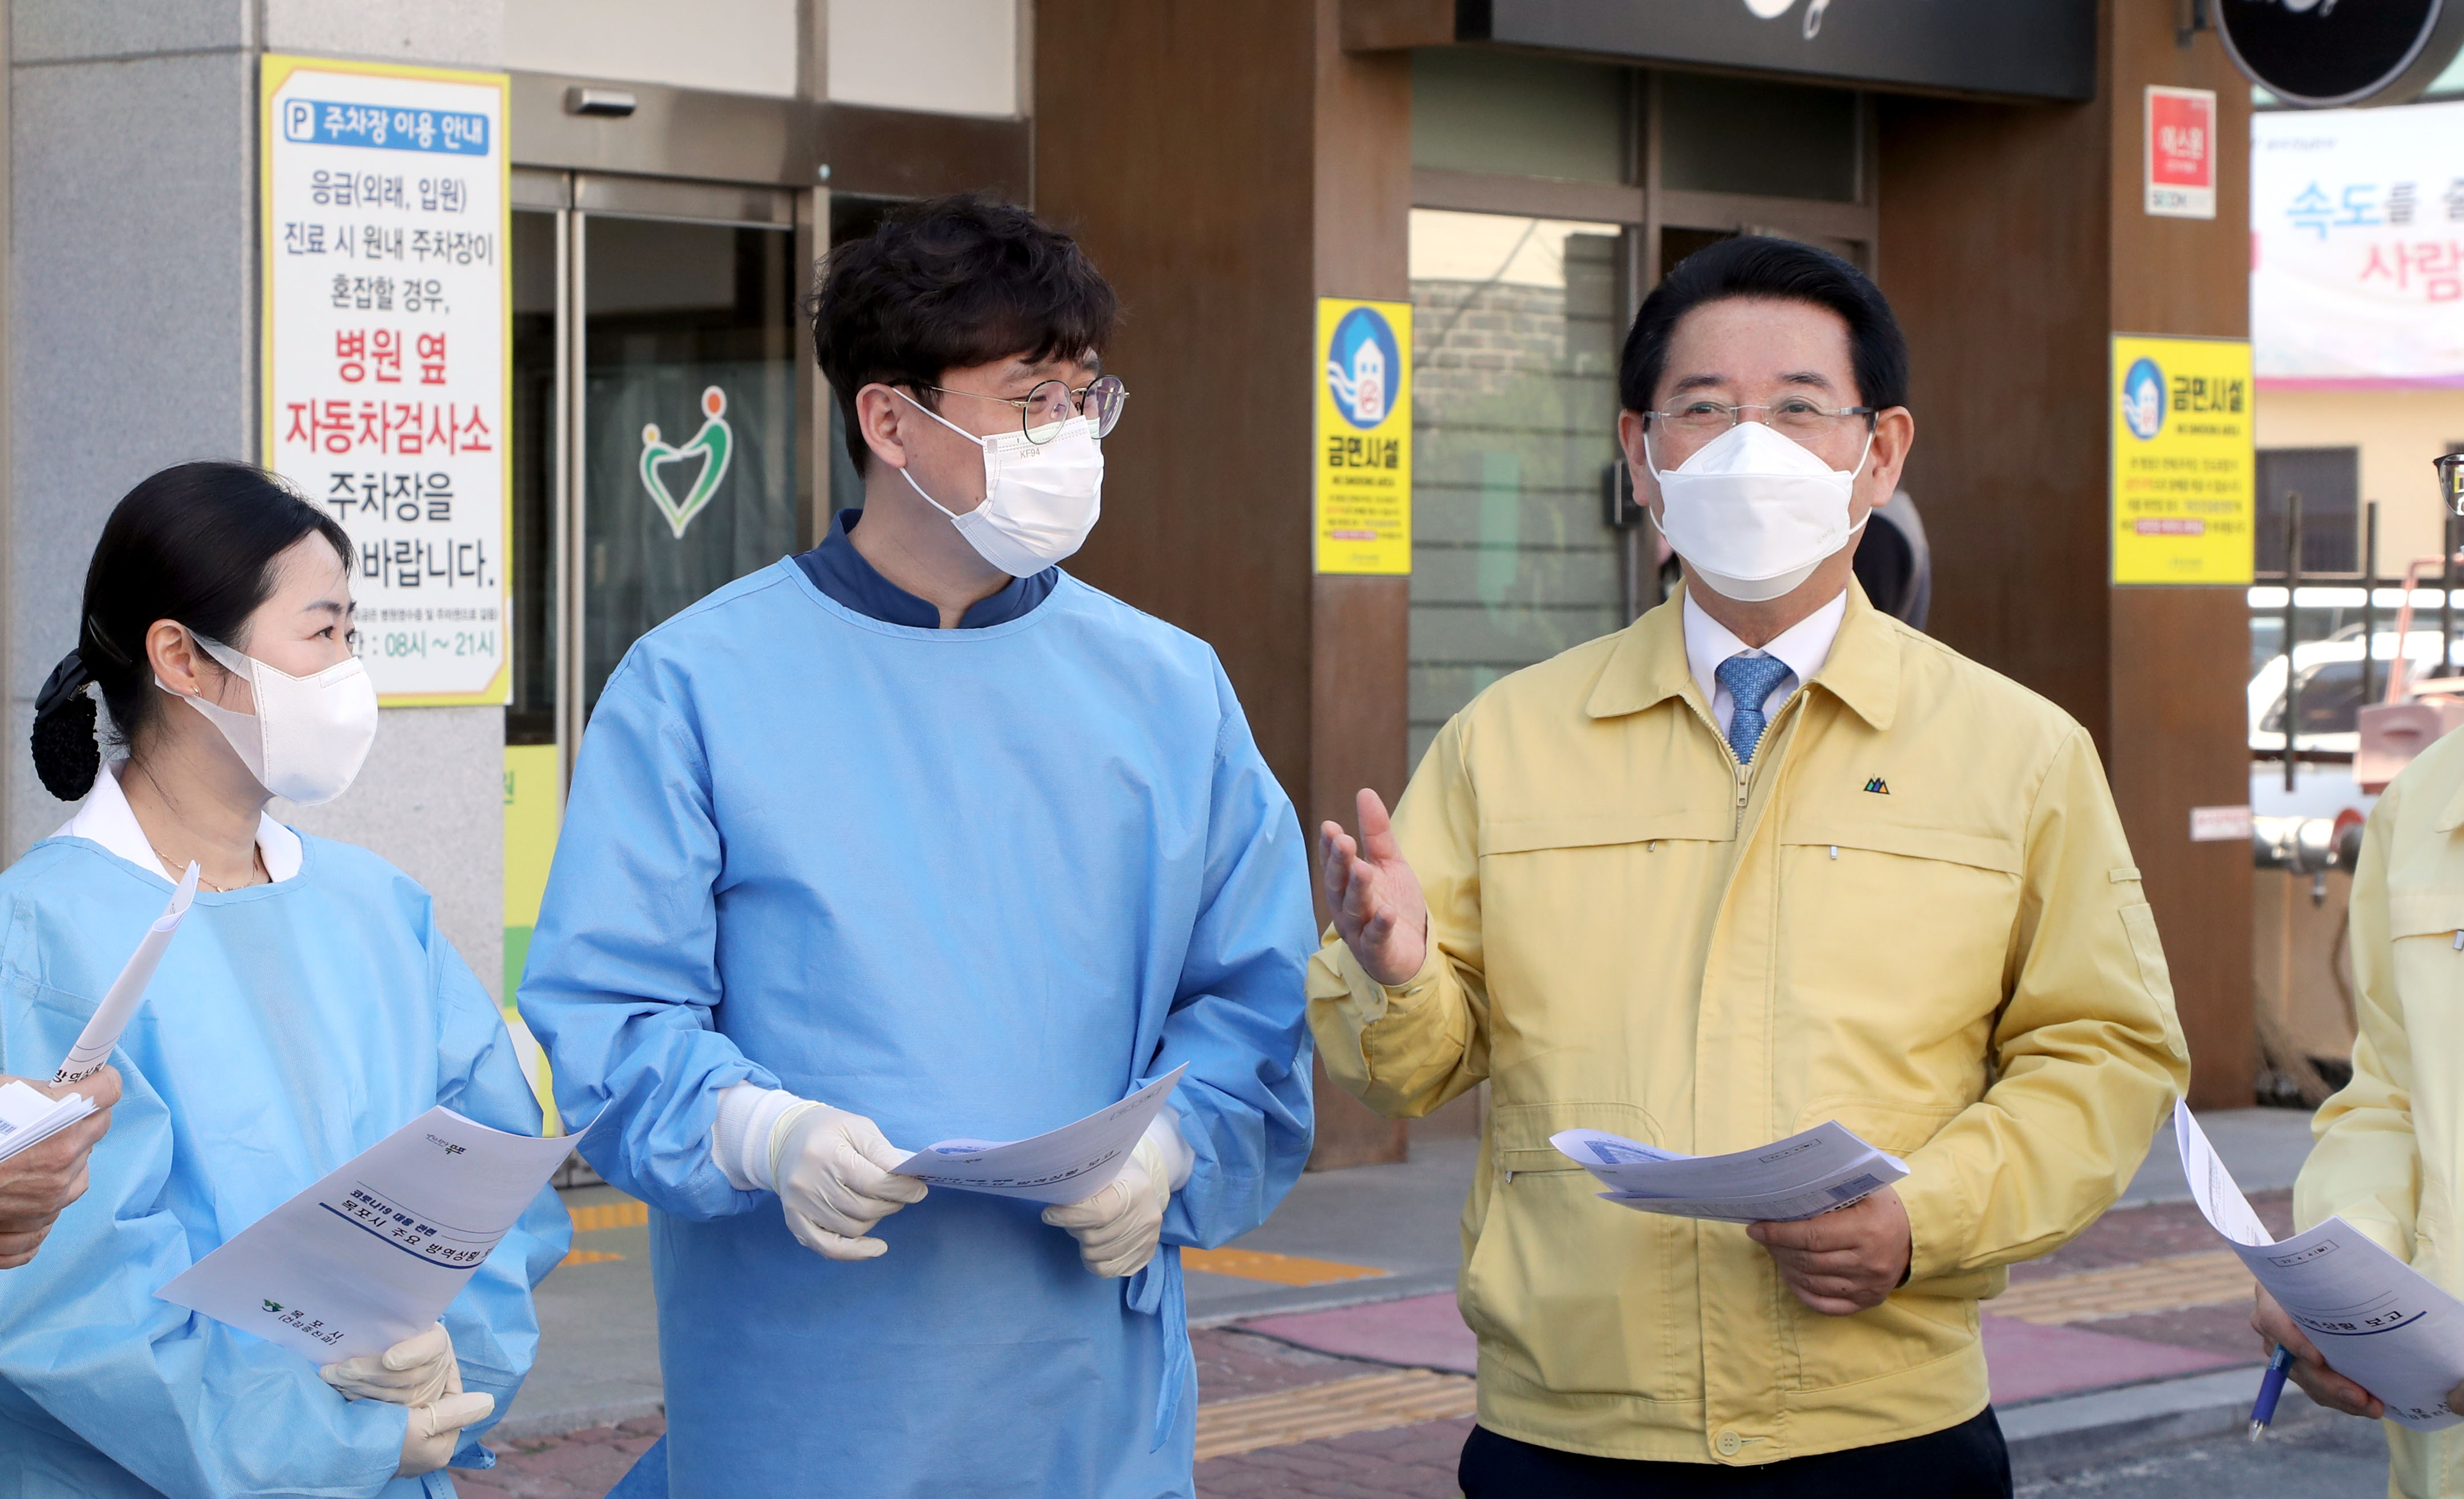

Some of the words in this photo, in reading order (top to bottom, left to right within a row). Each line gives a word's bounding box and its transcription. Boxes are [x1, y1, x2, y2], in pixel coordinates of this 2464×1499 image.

[293, 107, 307, 134] P
[323, 106, 389, 145] 주차장
[394, 112, 436, 148] 이용
[442, 115, 483, 149] 안내
[311, 169, 411, 211] 응급(외래,
[419, 177, 467, 213] 입원)
[2286, 181, 2417, 241] 속도를
[285, 221, 326, 256] 진료
[334, 225, 355, 258] 시
[363, 224, 404, 262] 원내
[411, 230, 493, 266] 주차장이
[331, 273, 394, 310] 혼잡할
[403, 279, 450, 314] 경우,
[2360, 241, 2464, 302] 사람
[335, 329, 402, 383] 병원
[416, 332, 446, 385] 옆
[2174, 377, 2243, 413] 금연시설
[286, 398, 492, 455] 자동차검사소
[1020, 448, 1041, 459] KF94
[1330, 436, 1398, 468] 금연시설
[327, 471, 453, 522] 주차장을
[363, 539, 495, 588] 바랍니다.
[385, 631, 426, 657] 08시
[455, 630, 495, 657] 21시
[342, 1199, 387, 1227] 목포시
[391, 1227, 420, 1246] 주요
[426, 1243, 480, 1262] 방역상황
[350, 1189, 393, 1215] 코로나19
[393, 1213, 414, 1227] 대응
[415, 1223, 438, 1237] 관련
[278, 1314, 337, 1346] (건강증진과)
